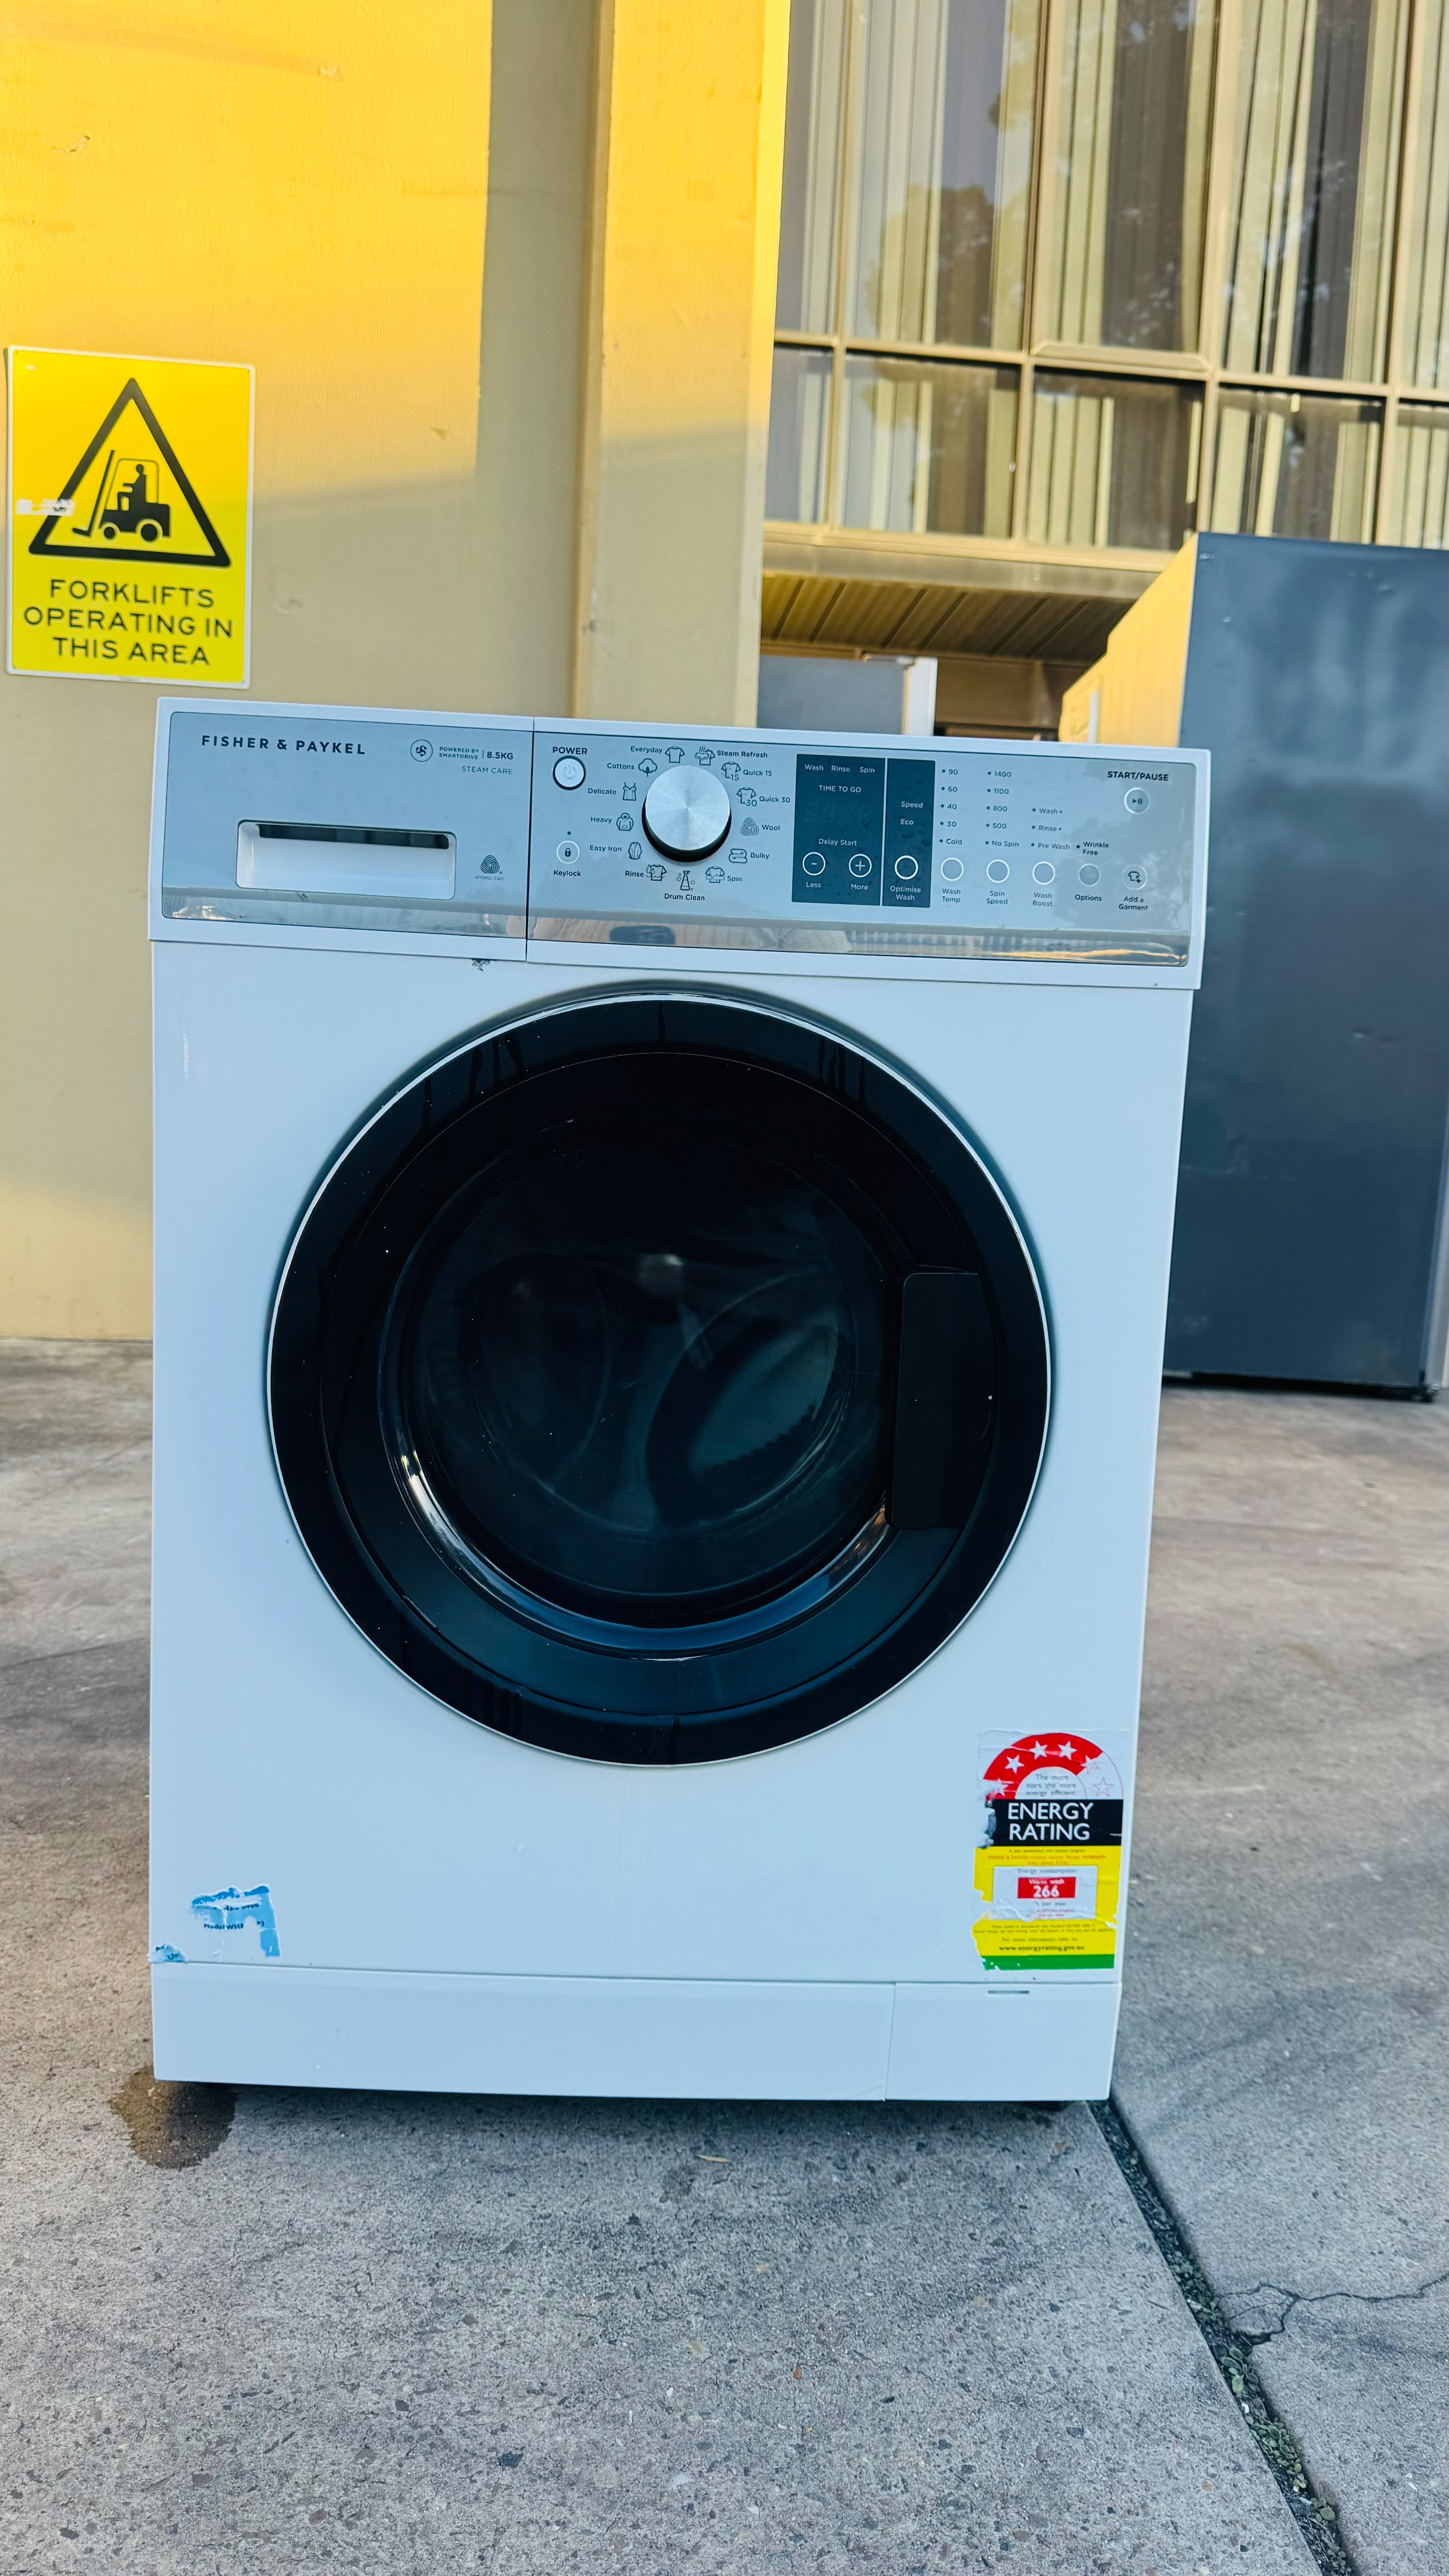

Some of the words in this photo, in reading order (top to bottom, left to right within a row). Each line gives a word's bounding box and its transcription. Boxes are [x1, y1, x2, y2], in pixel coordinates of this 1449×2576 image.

[50, 579, 214, 608] FORKLIFTS
[24, 606, 196, 635] OPERATING
[205, 618, 233, 638] IN
[53, 636, 119, 660] THIS
[128, 642, 210, 666] AREA
[202, 735, 269, 750] FISHER
[277, 739, 287, 750] &
[296, 740, 366, 755] PAYKEL
[552, 746, 588, 755] POWER
[630, 746, 663, 755] Everyday
[717, 750, 739, 758] Steam
[741, 750, 768, 759] Refresh
[487, 751, 513, 760] 8.5KG
[607, 762, 635, 770] Cottons
[743, 769, 764, 777] Quick
[1107, 771, 1169, 782] START/PAUSE
[588, 787, 617, 795] Delicate
[746, 799, 757, 807] 30
[759, 795, 779, 804] Quick
[901, 801, 923, 809] Speed
[590, 817, 612, 825] Heavy
[819, 838, 838, 846] Delay
[590, 845, 606, 853] Easy
[750, 852, 770, 861] Bulky
[553, 869, 581, 877] Keylock
[890, 886, 921, 894] Optimise
[1075, 894, 1102, 902] Options
[1008, 1802, 1094, 1820] ENERGY
[1009, 1823, 1090, 1841] RATING
[1033, 1885, 1060, 1898] 266
